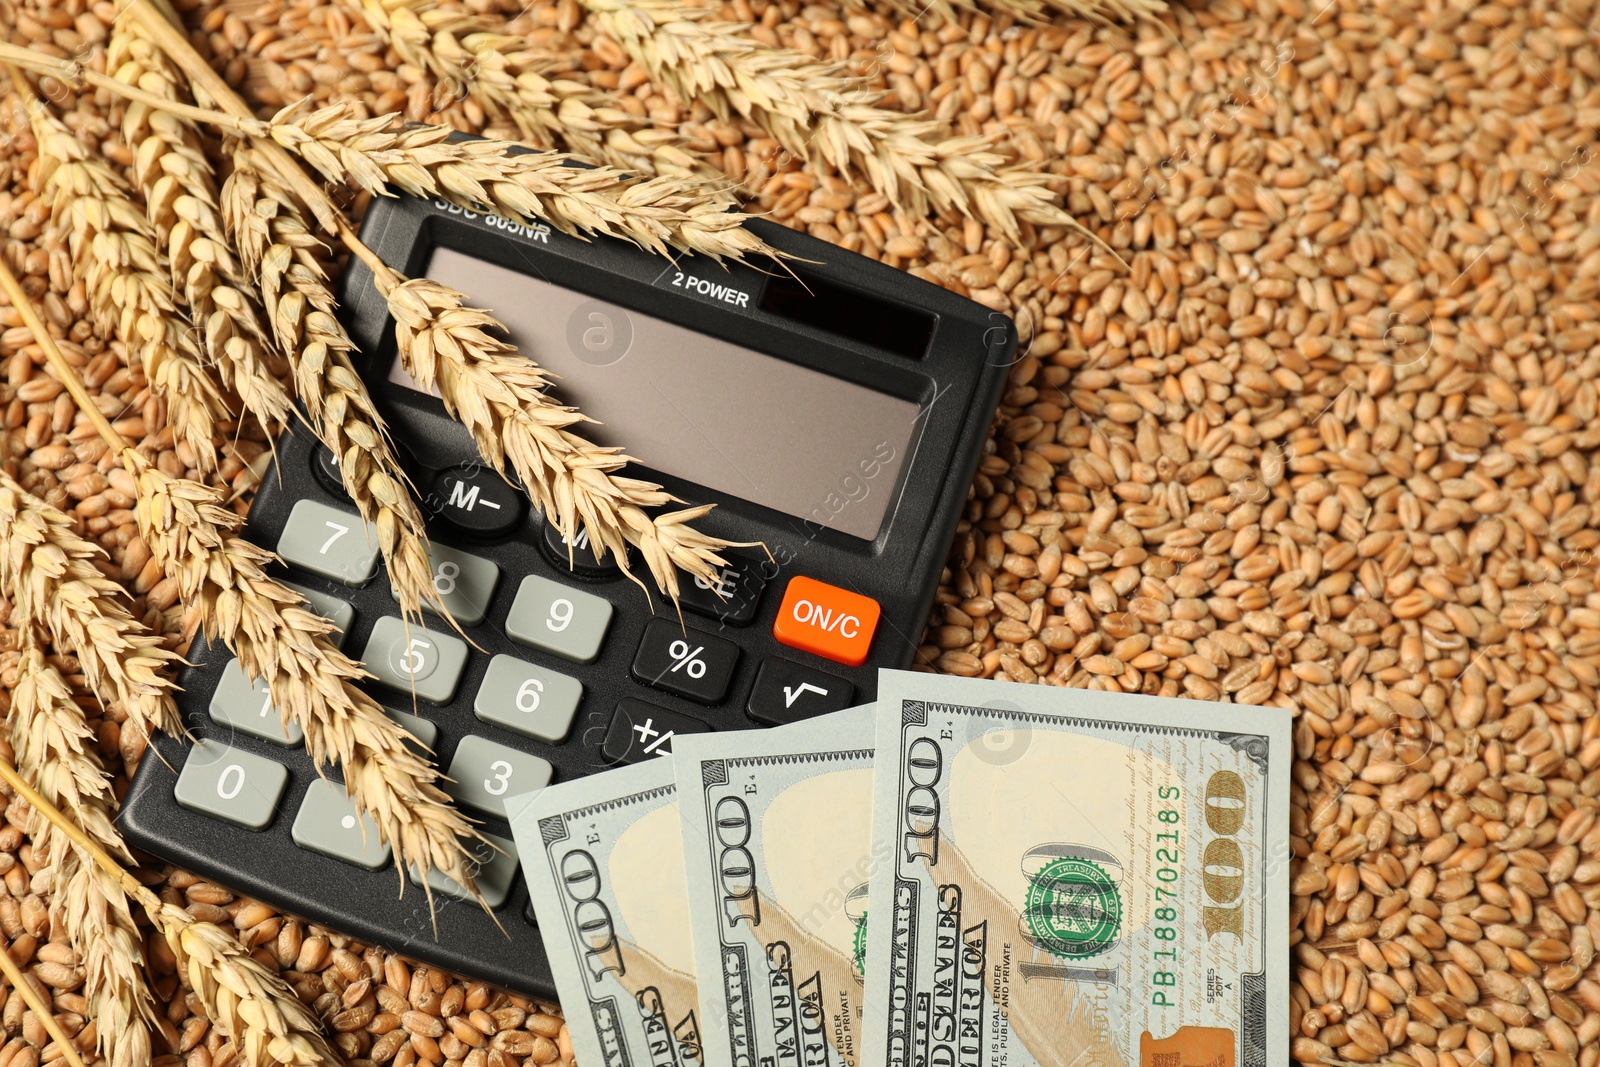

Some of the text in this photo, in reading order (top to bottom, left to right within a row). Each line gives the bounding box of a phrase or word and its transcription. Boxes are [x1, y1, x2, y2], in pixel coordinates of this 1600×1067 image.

[672, 272, 750, 308] 2 POWER
[319, 520, 350, 555] 7
[433, 561, 460, 595] 8
[546, 598, 575, 632] 9
[793, 600, 860, 639] ON/C
[400, 638, 431, 674] 5
[515, 678, 544, 713] 6
[216, 764, 246, 800] 0
[484, 760, 514, 796] 3
[905, 737, 943, 866] 100
[715, 795, 761, 928] 100
[1202, 769, 1248, 946] 100
[1033, 891, 1043, 904] OF
[1057, 864, 1103, 882] TREASURY
[560, 848, 626, 983] 100
[891, 887, 913, 1034] DOLLARS
[931, 884, 962, 1041] STATES
[993, 964, 1001, 1004] TENDER
[1000, 942, 1010, 1048] PUBLIC AND PRIVATE
[1206, 968, 1215, 1003] SERIES
[1215, 974, 1223, 996] 2017
[1224, 982, 1232, 990] A
[835, 1014, 843, 1055] TENDER
[991, 1008, 999, 1039] LEGAL
[991, 1043, 998, 1052] IS
